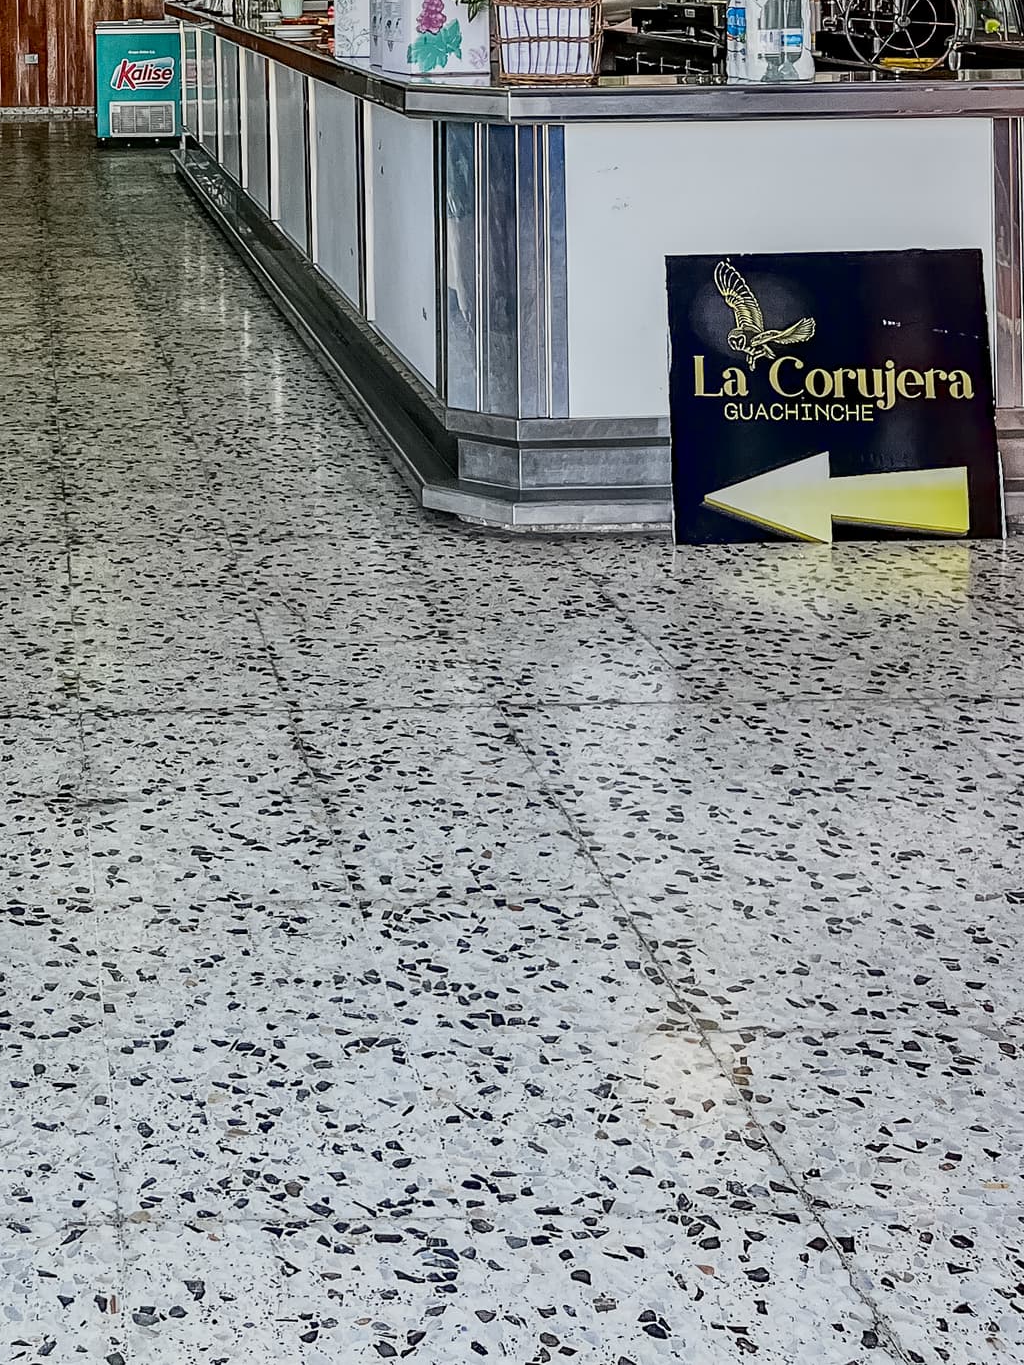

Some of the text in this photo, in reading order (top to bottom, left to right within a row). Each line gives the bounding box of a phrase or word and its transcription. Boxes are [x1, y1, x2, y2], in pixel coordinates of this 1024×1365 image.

[117, 60, 173, 89] Kalise
[693, 355, 974, 410] La Corujera
[724, 403, 874, 422] GUACHINCHE
